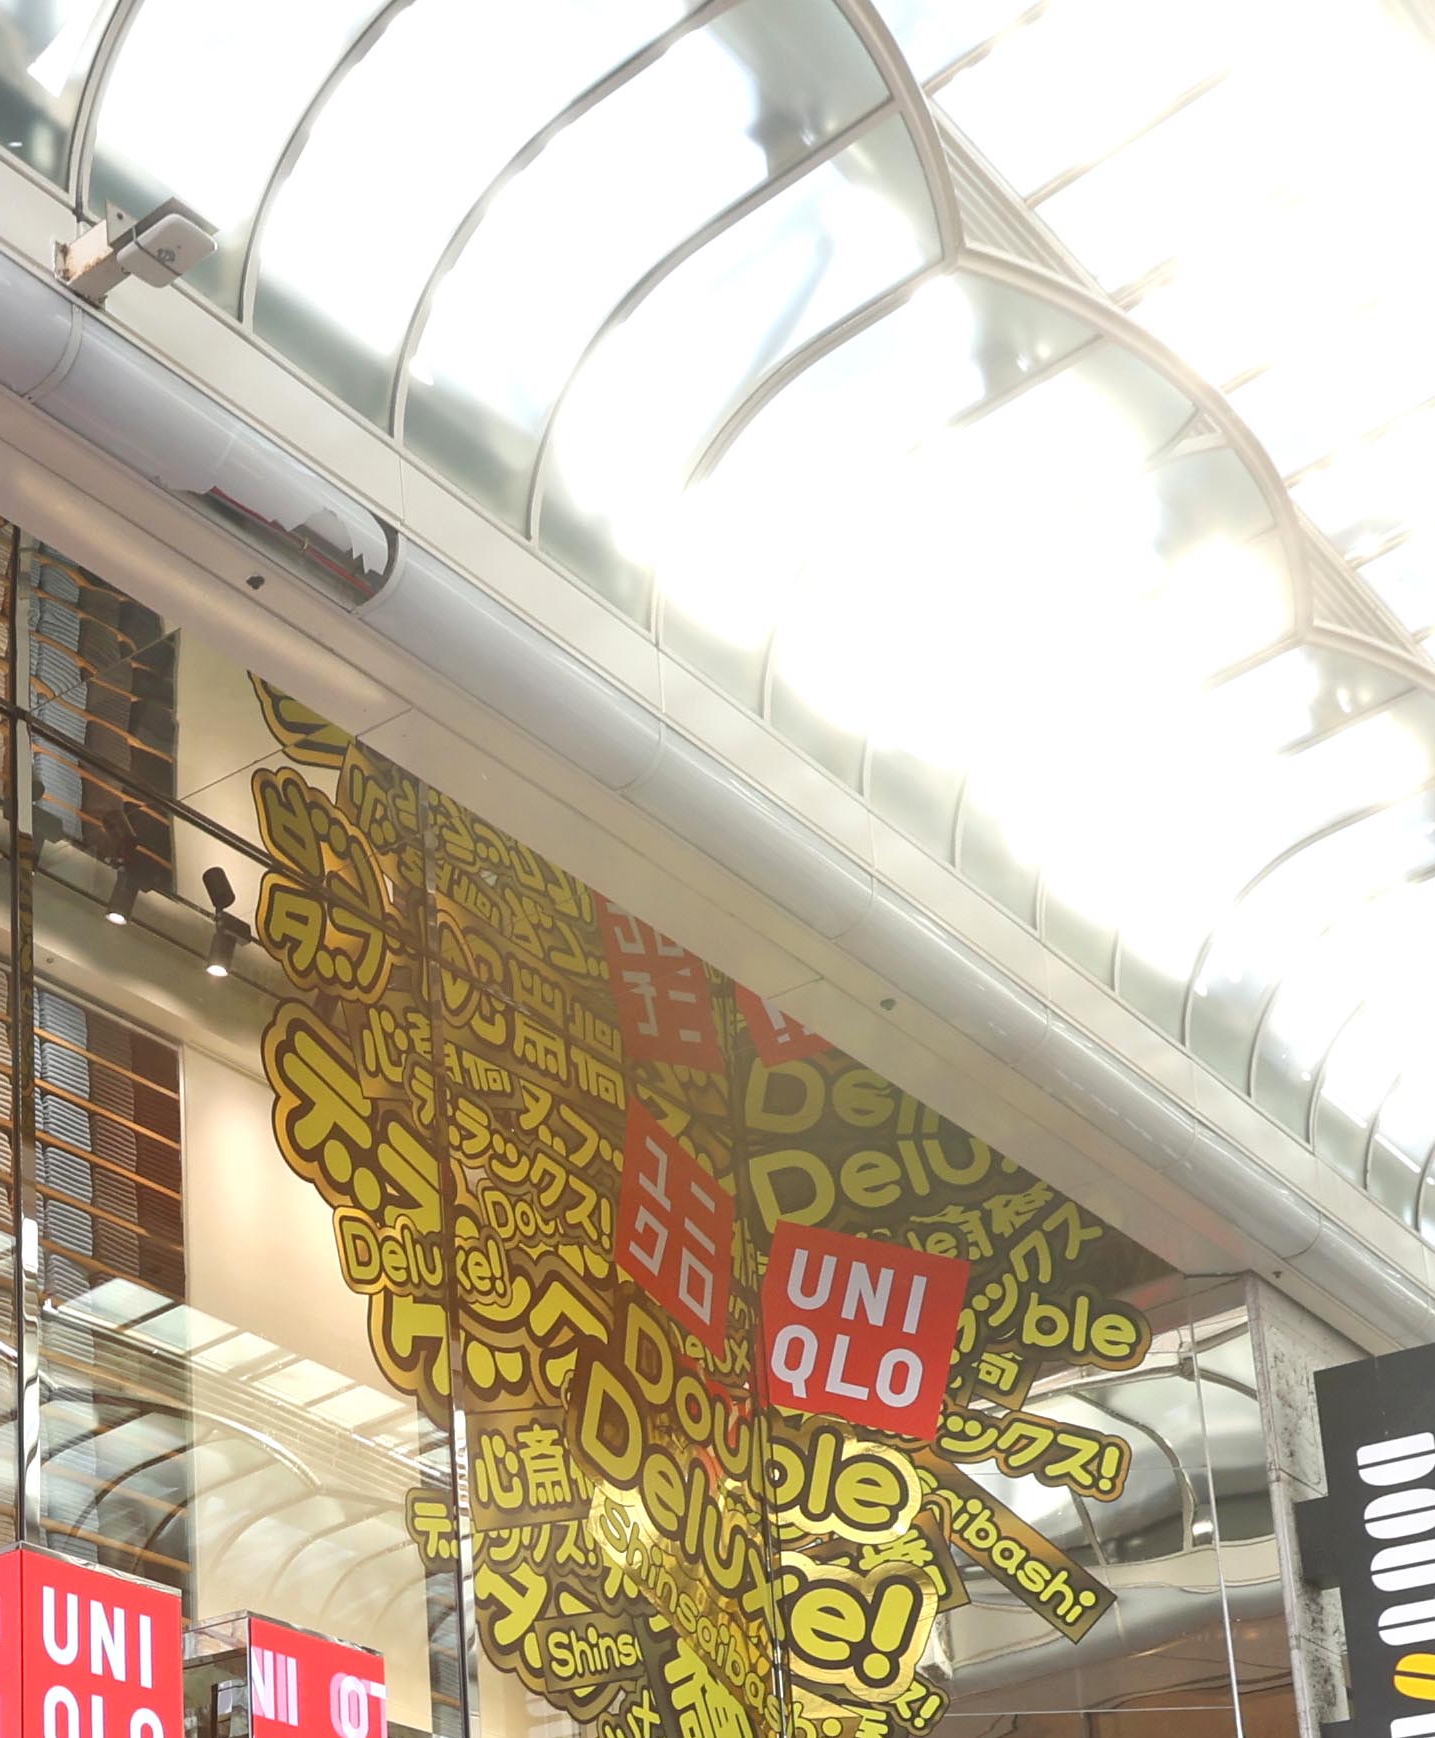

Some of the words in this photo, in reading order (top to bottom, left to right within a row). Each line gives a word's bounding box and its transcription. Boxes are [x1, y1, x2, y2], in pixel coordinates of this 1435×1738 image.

[786, 1249, 928, 1334] UNI
[771, 1323, 923, 1408] QLO
[42, 1585, 152, 1689] UNI
